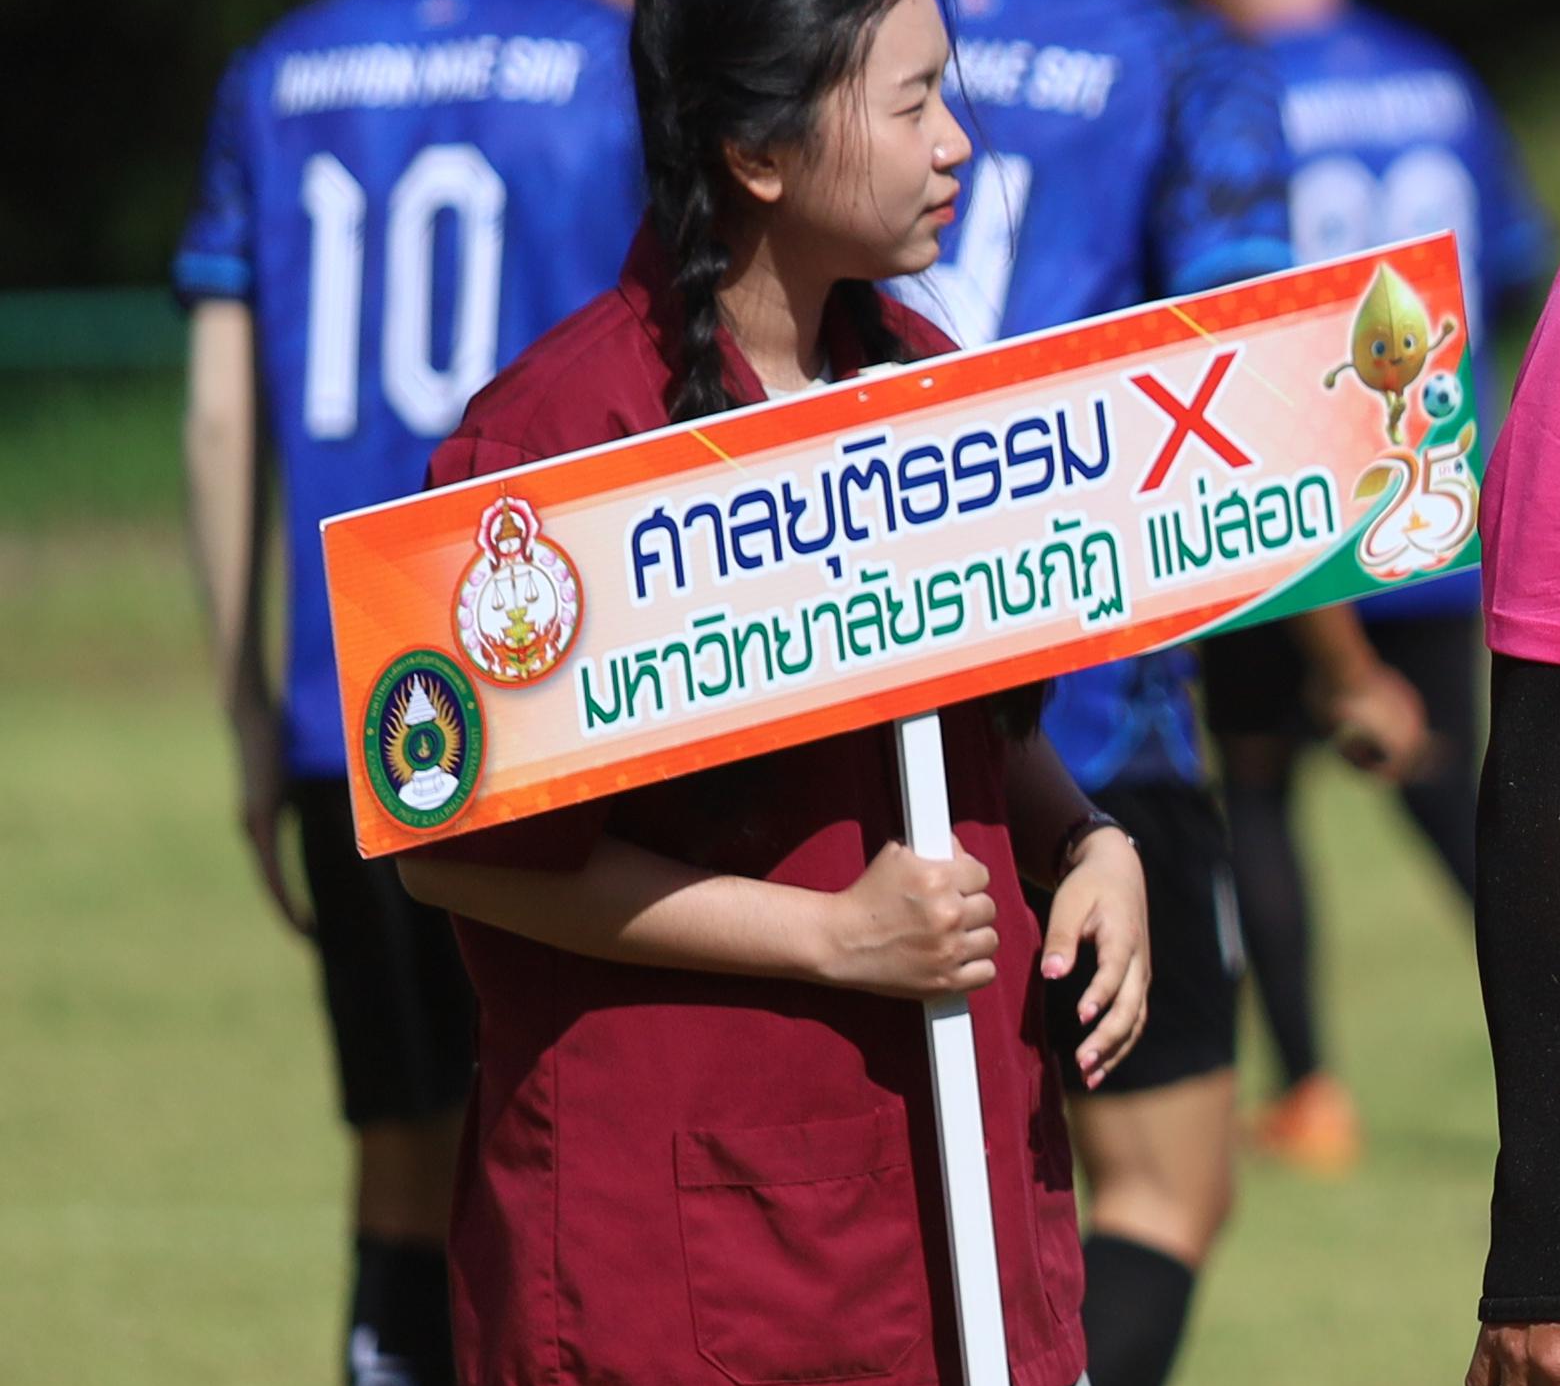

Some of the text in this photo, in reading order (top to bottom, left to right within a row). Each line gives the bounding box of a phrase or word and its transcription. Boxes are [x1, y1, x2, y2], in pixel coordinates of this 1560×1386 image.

[302, 143, 506, 439] 10
[581, 517, 1126, 729] มหาวิทยาลัยราชภัฏ
[1148, 475, 1335, 580] แม่สอด
[630, 353, 1252, 599] ศาลยุติธรรม X
